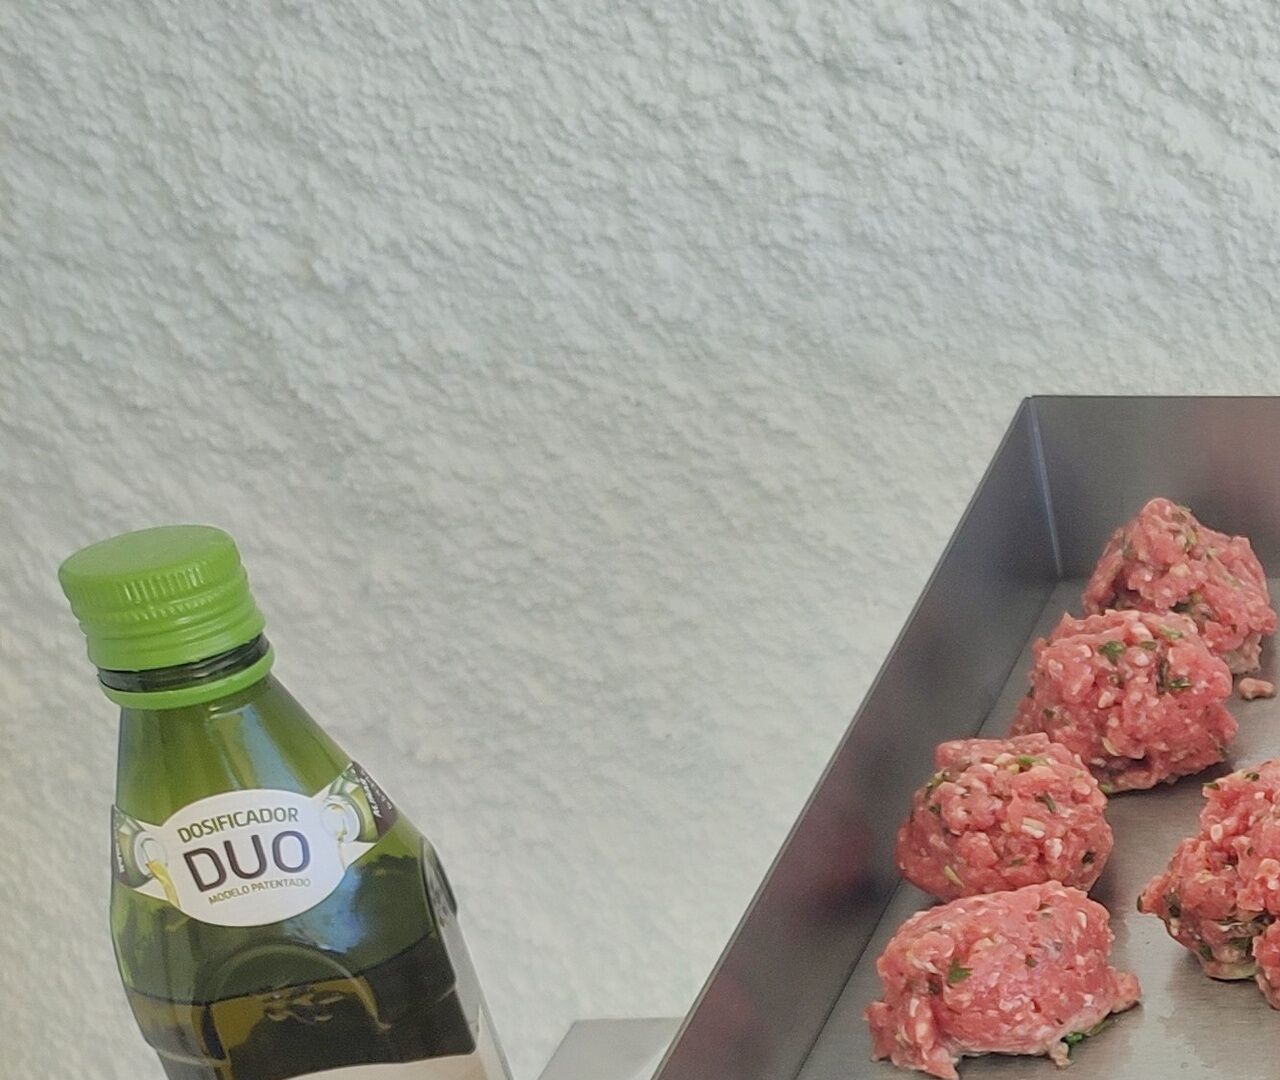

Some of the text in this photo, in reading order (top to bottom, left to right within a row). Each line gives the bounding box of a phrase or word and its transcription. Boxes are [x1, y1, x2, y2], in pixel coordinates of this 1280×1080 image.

[177, 807, 299, 843] DOSIFICADOR
[182, 830, 311, 893] DUO
[208, 878, 312, 905] MODELO PATENTADO
